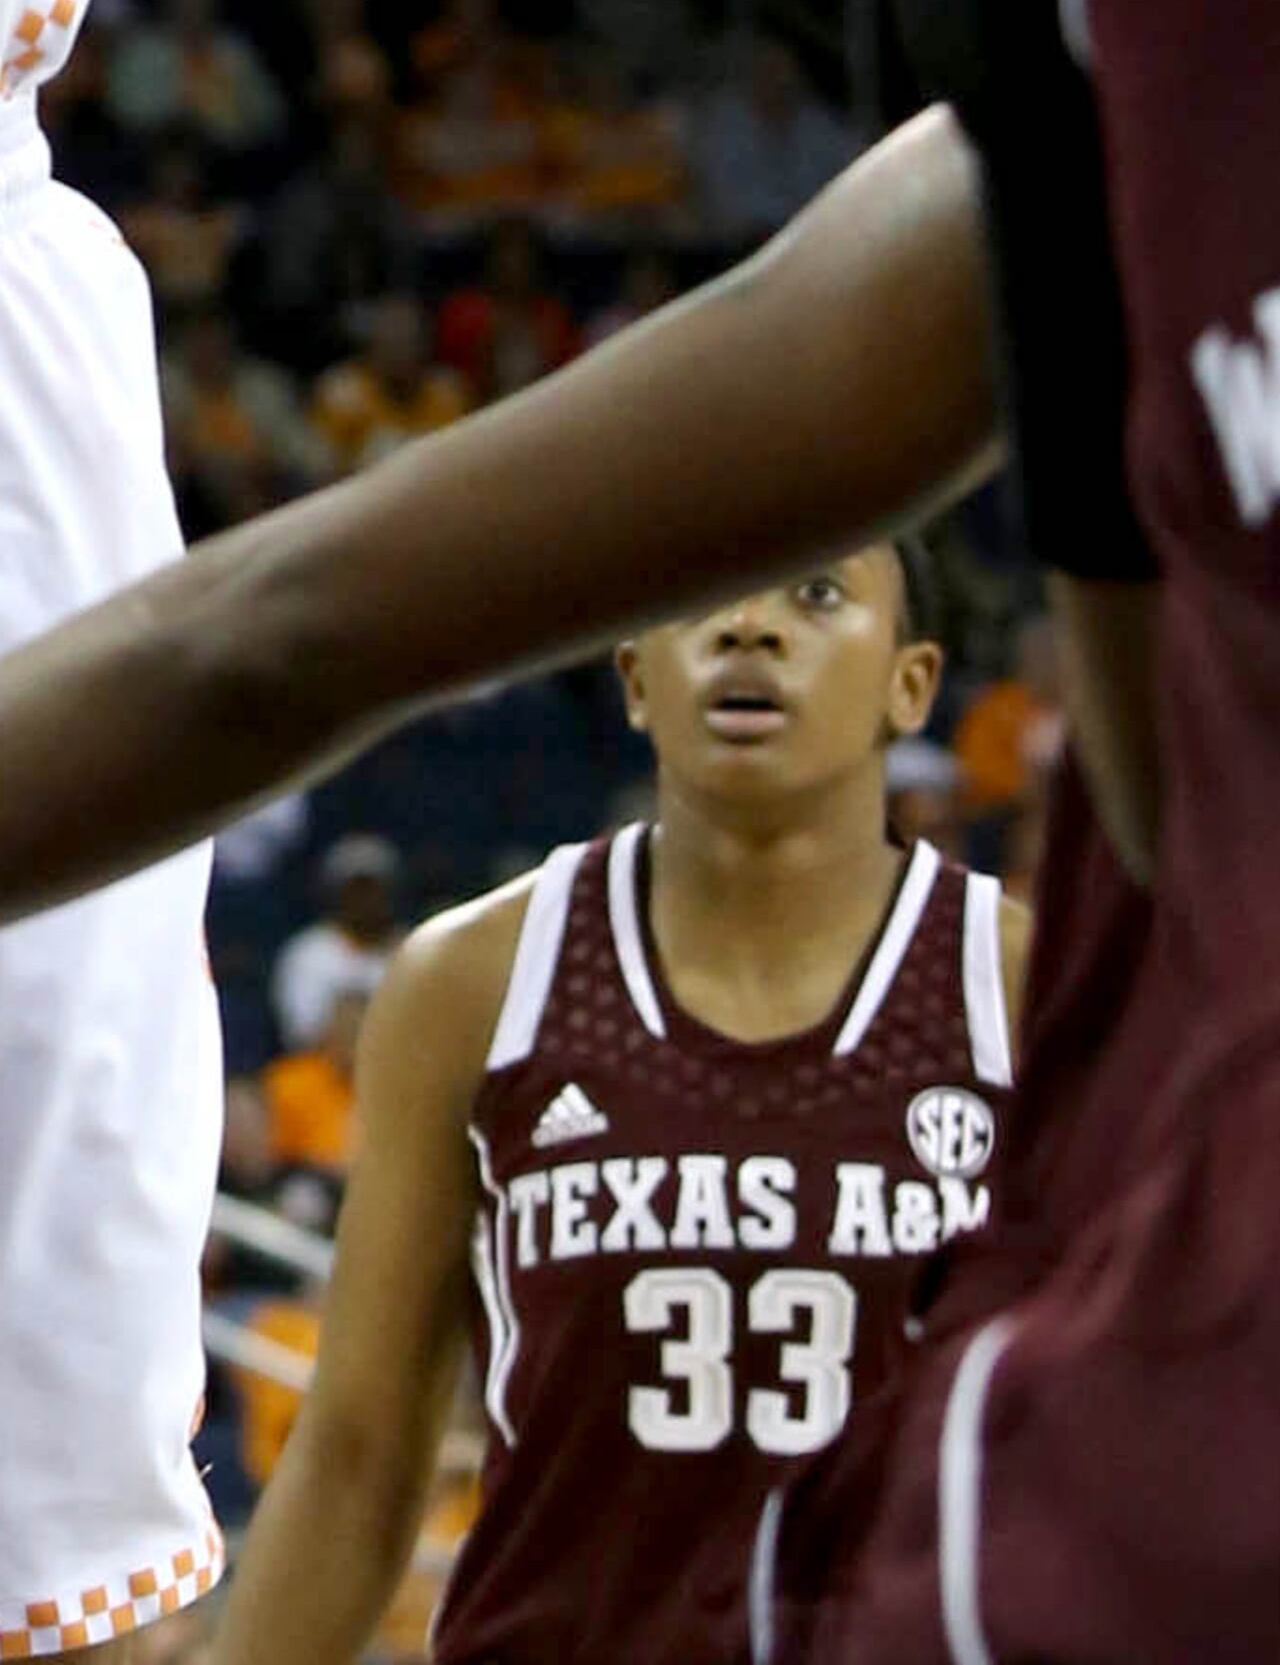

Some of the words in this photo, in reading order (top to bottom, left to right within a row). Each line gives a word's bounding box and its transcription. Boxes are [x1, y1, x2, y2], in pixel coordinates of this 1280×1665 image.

[914, 1093, 990, 1173] SEC
[509, 1155, 797, 1270] TEXAS
[623, 1268, 857, 1455] 33
